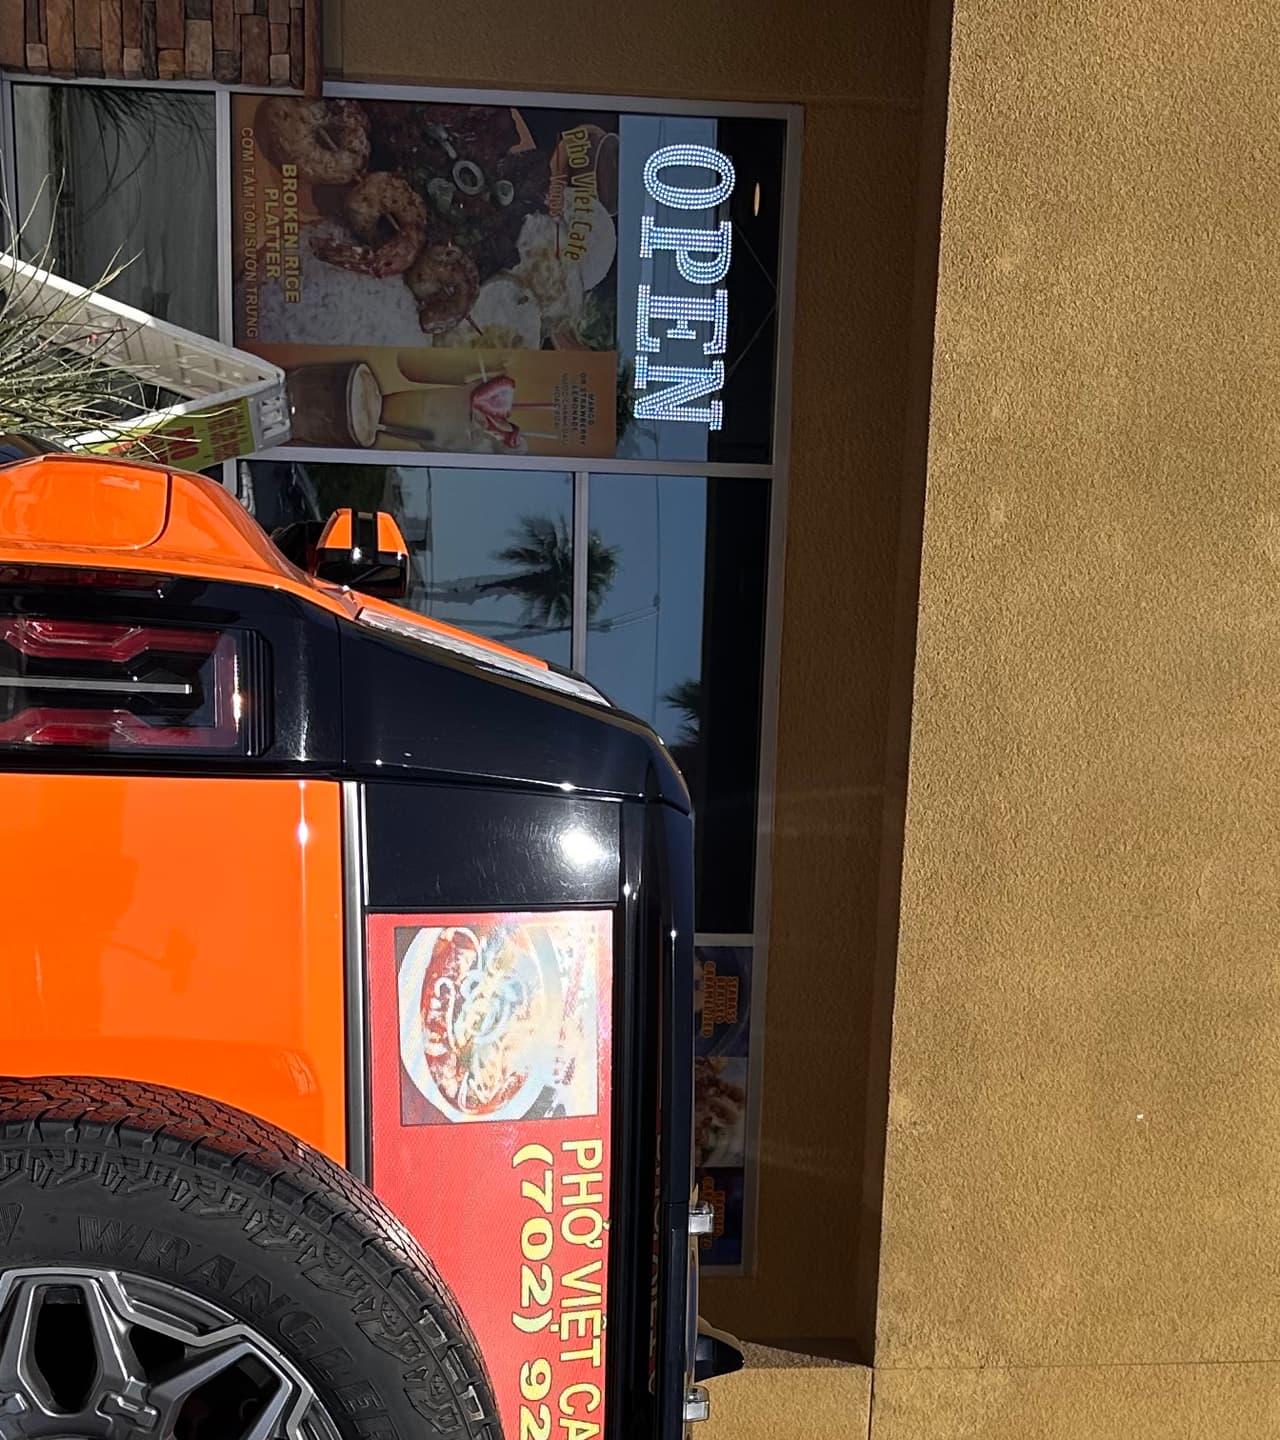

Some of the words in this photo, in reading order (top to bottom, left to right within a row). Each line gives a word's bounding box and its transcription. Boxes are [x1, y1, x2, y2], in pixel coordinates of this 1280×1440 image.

[263, 188, 281, 279] PLATTER
[281, 164, 299, 249] BROKEN
[544, 174, 568, 217] Vegas
[283, 256, 301, 304] RICE
[563, 221, 593, 262] Cafe
[632, 144, 736, 432] OPEN
[511, 1143, 555, 1334] (702)
